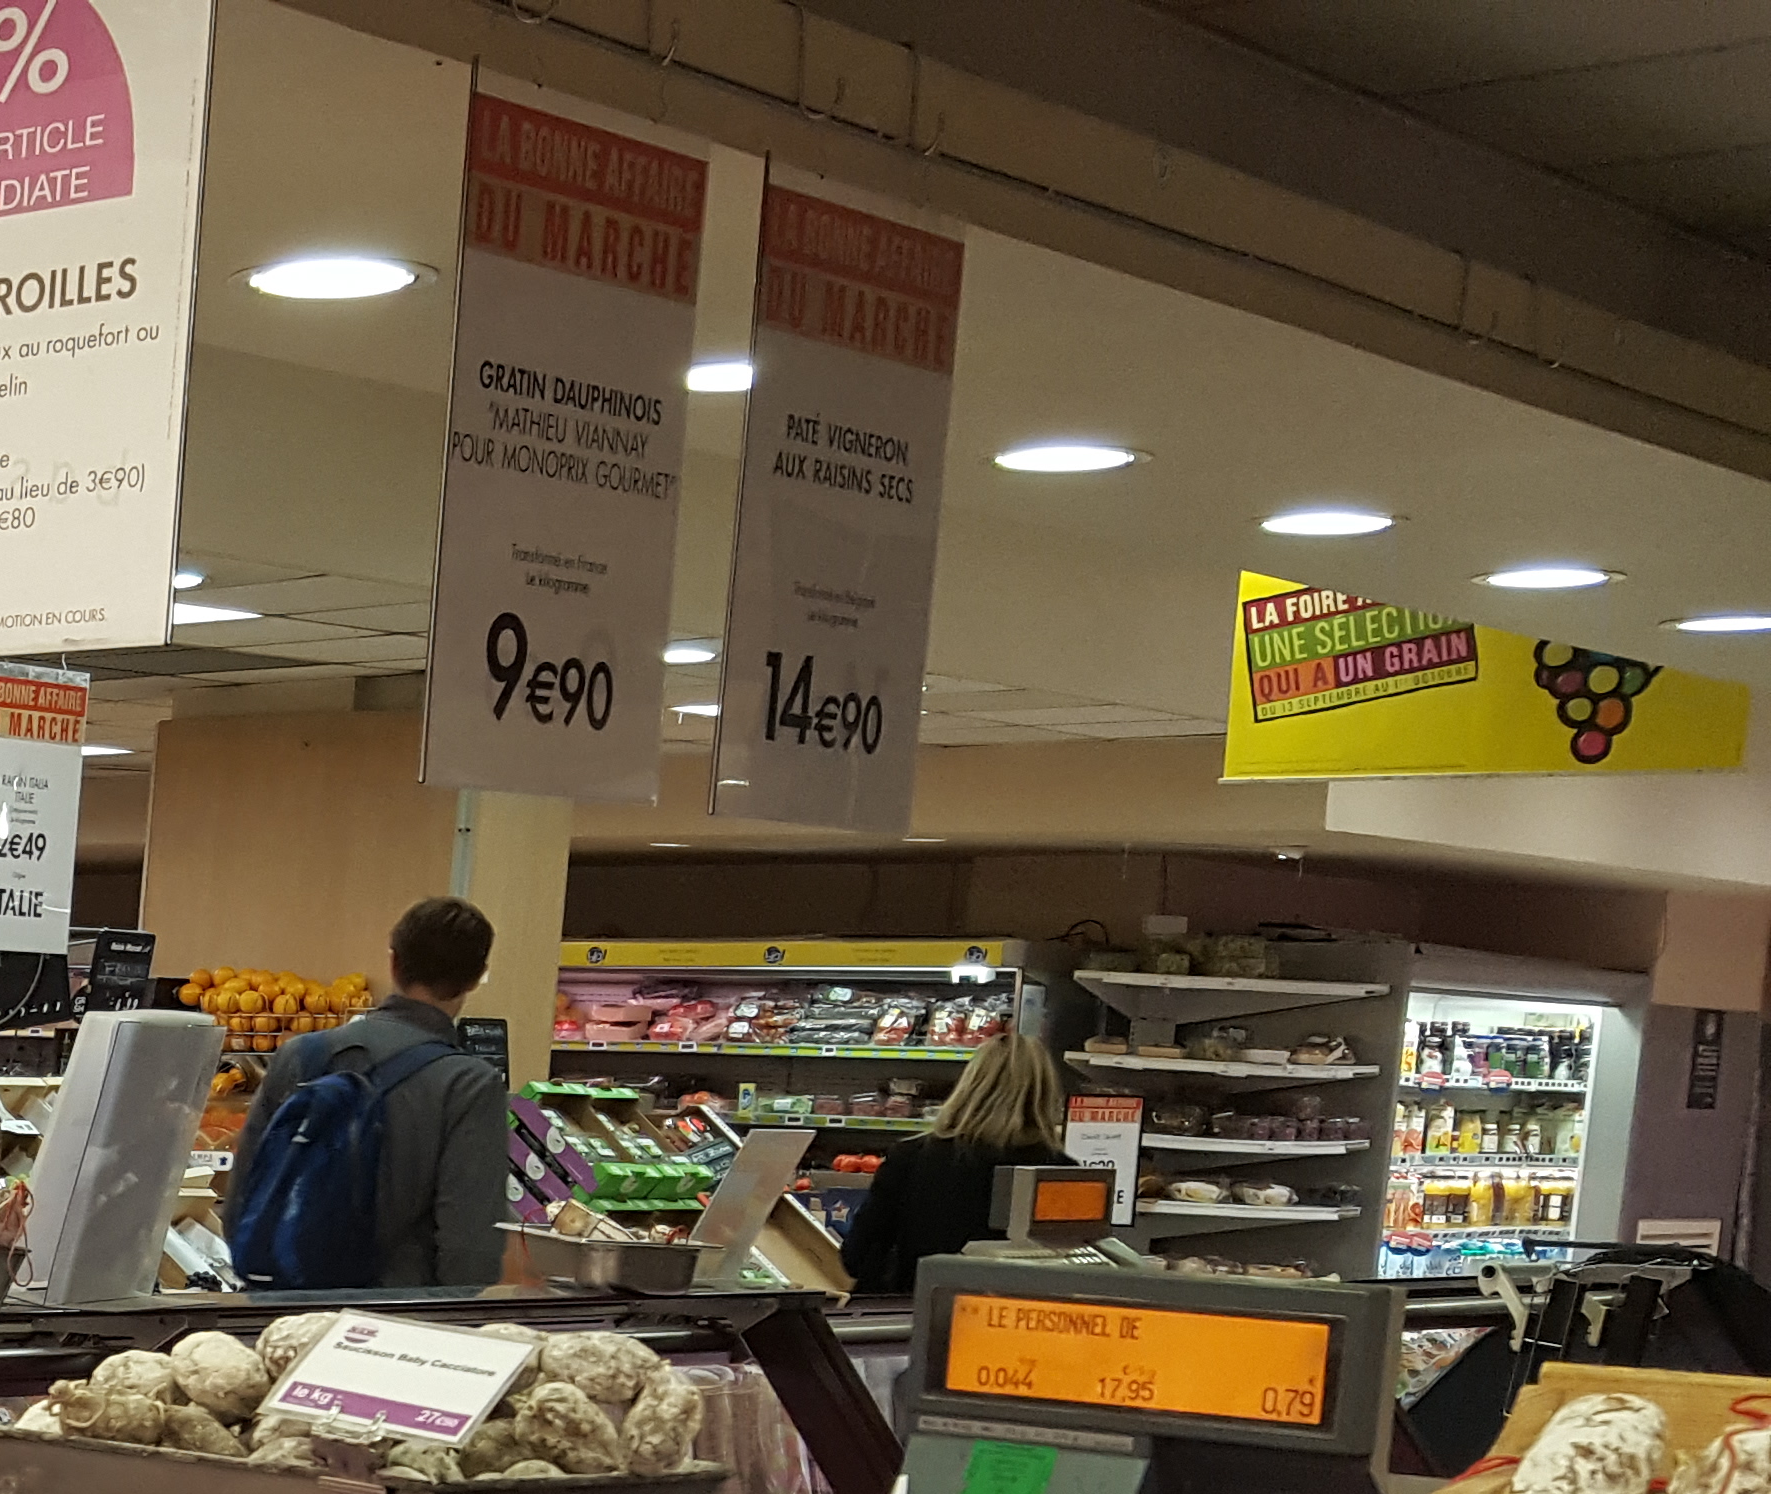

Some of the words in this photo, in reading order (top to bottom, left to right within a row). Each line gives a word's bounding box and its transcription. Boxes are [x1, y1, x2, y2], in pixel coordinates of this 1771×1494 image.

[520, 119, 601, 190] BONNE
[475, 182, 523, 250] DU
[18, 341, 41, 358] au
[45, 322, 131, 359] roquefort
[136, 324, 160, 342] ou
[479, 360, 547, 401] GRATIN
[553, 376, 662, 426] DAUPHINOIS
[452, 430, 495, 467] POUR
[502, 442, 590, 485] MONOPRIX
[575, 418, 651, 460] VIANNAY
[786, 412, 821, 446] PATÉ
[828, 423, 909, 467] VIGNERON
[19, 475, 50, 500] lieu
[56, 471, 79, 496] de
[85, 462, 146, 493] 3€90)
[773, 451, 808, 480] AUX
[813, 459, 873, 495] RAISINS
[878, 473, 914, 504] SECS
[45, 611, 62, 626] EN
[1250, 601, 1280, 630] LA
[1285, 588, 1349, 622] FOIRE
[1253, 627, 1308, 667] UNE
[1260, 668, 1301, 701] QUI
[1313, 662, 1329, 688] A
[1337, 651, 1375, 683] UN
[1384, 632, 1469, 674] GRAIN
[485, 611, 614, 731] 9€90
[38, 686, 83, 711] AFFAIRE
[764, 650, 883, 754] 14€90
[1281, 701, 1294, 714] 13
[1299, 683, 1368, 710] SEPTEMBRE
[1373, 682, 1390, 695] AU
[986, 1305, 1011, 1329] LE
[1014, 1307, 1111, 1339] PERSONNEL
[1119, 1317, 1141, 1340] DE
[333, 1341, 396, 1361] Saucisson
[397, 1352, 428, 1367] Baby
[430, 1359, 497, 1377] Cacciatore
[293, 1385, 309, 1398] le
[311, 1389, 334, 1405] kg
[1260, 1387, 1316, 1418] 0,79
